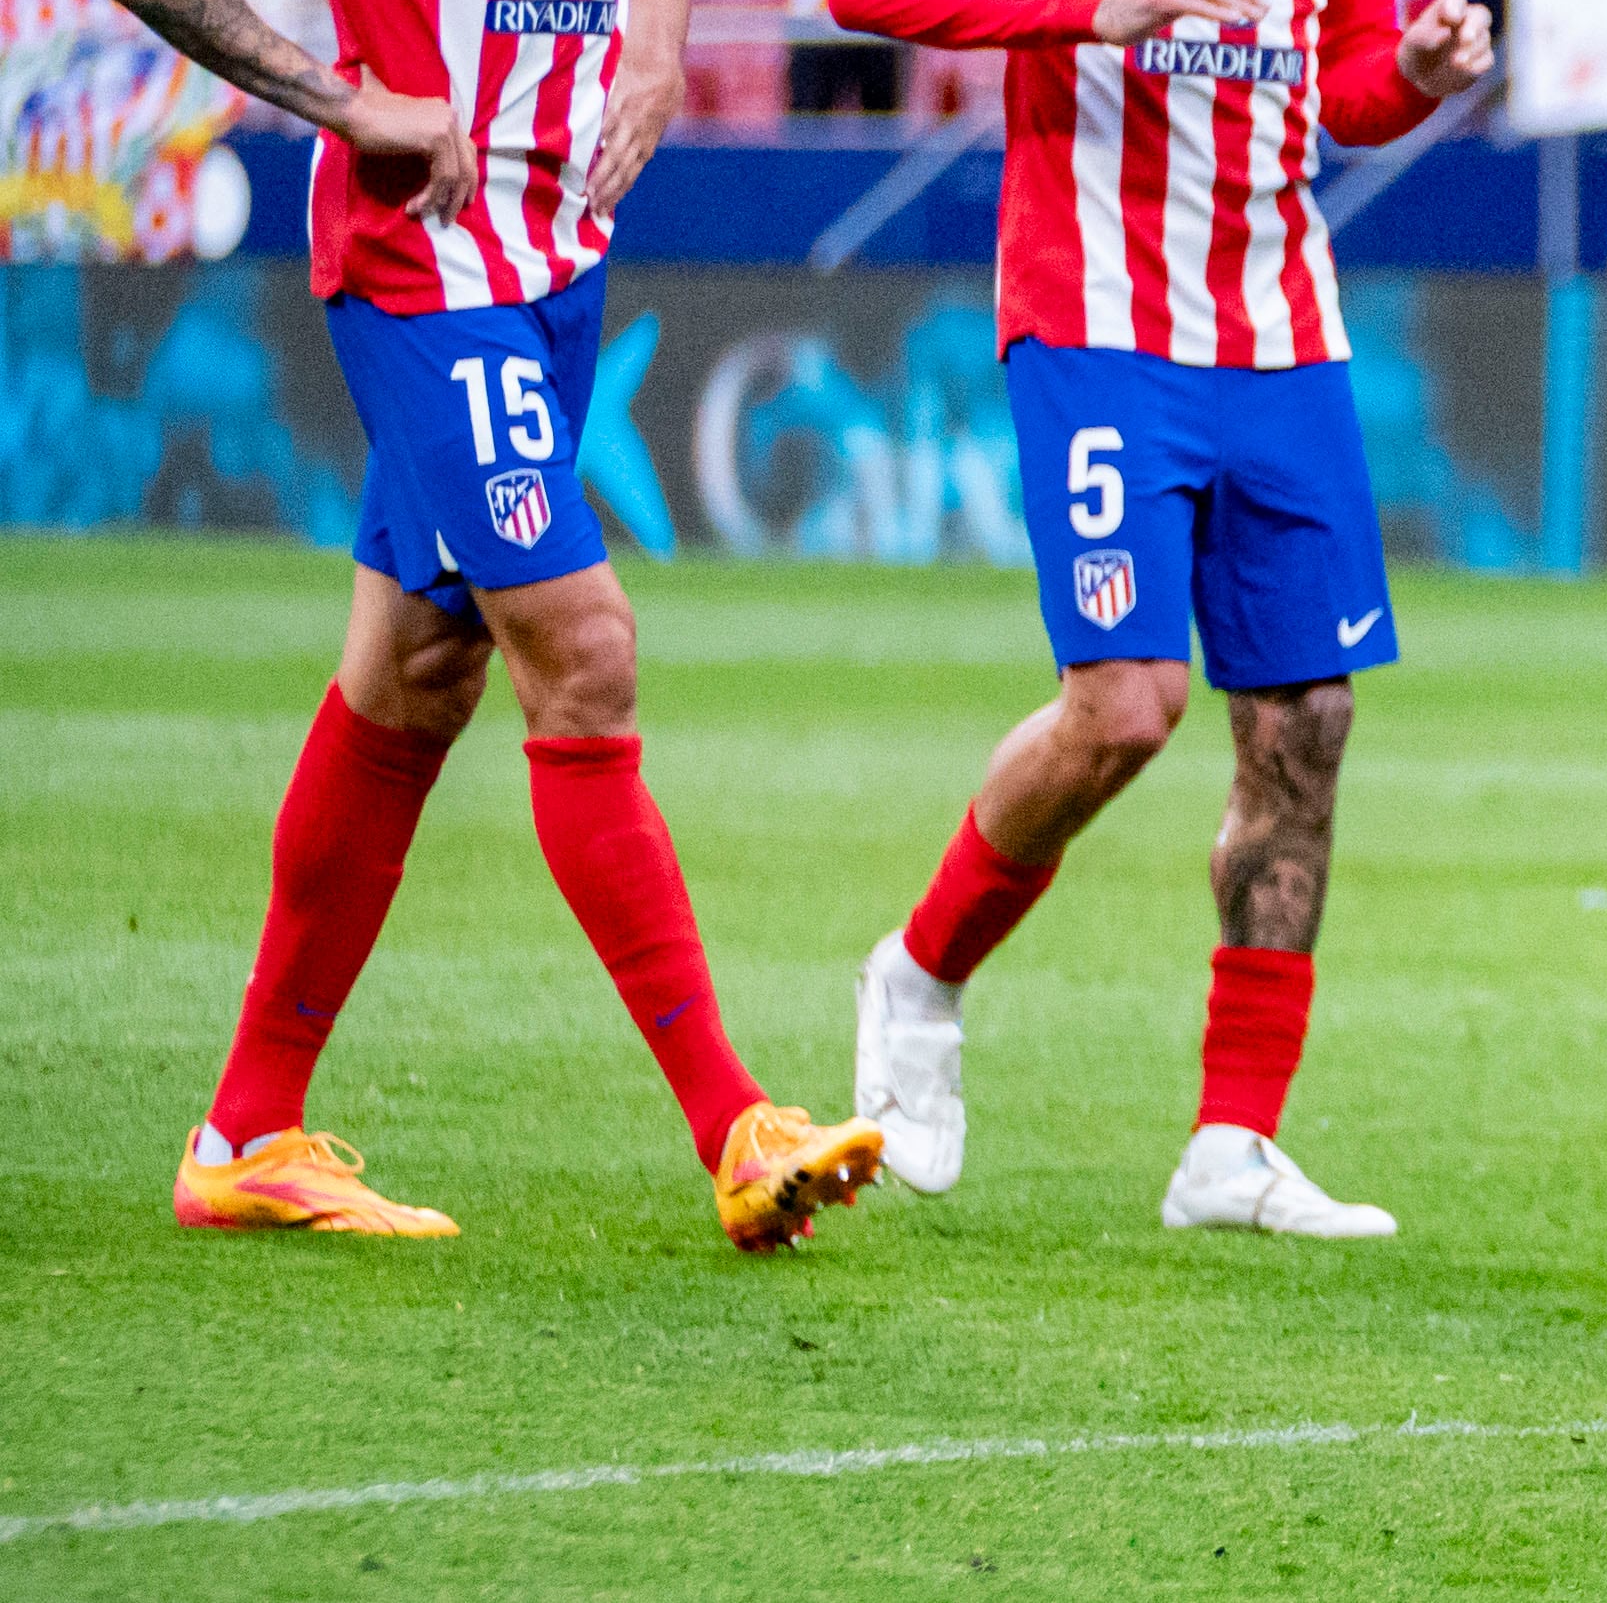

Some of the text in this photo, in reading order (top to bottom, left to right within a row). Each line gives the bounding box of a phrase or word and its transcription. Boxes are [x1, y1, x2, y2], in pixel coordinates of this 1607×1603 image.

[494, 0, 592, 33] RIYADH
[1142, 38, 1262, 79] RIYADH
[450, 356, 555, 466] 15
[1067, 426, 1125, 539] 5
